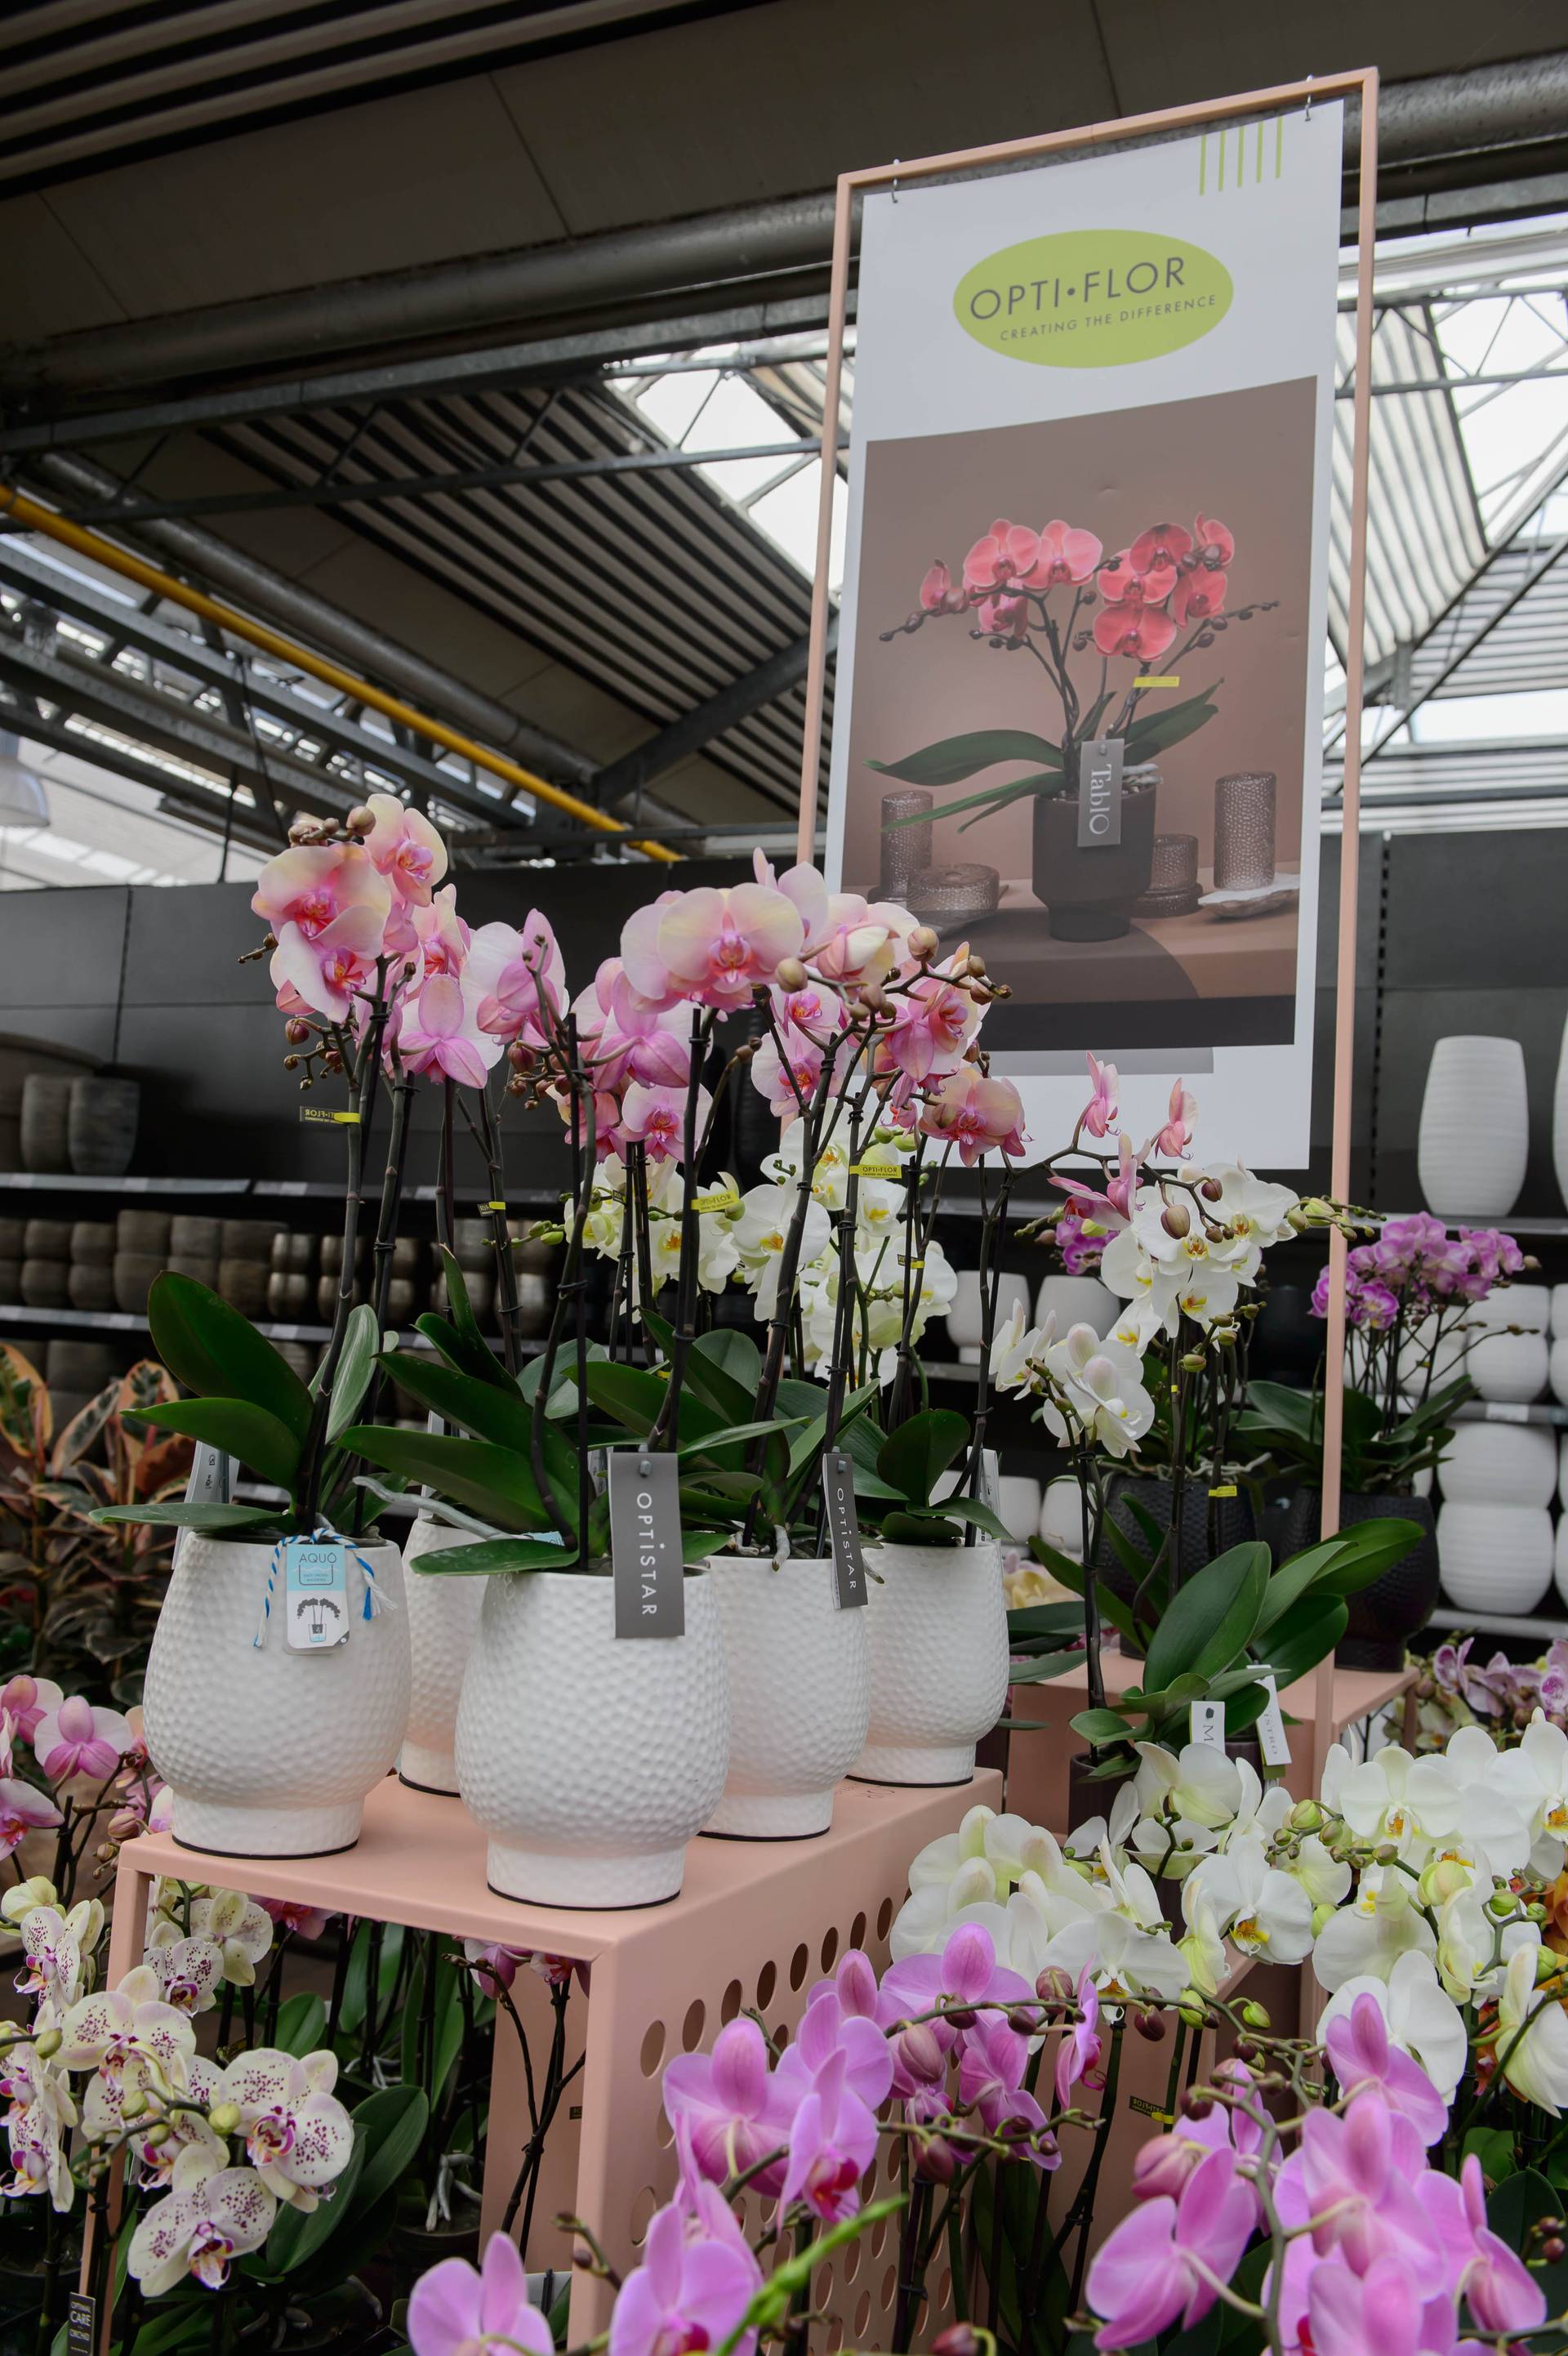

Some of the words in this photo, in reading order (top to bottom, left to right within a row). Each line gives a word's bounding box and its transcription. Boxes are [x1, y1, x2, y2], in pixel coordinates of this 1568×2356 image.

[1000, 319, 1078, 341] CREATING
[1085, 314, 1112, 328] THE
[1120, 294, 1217, 322] DIFFERENCE
[1089, 763, 1111, 835] TablO
